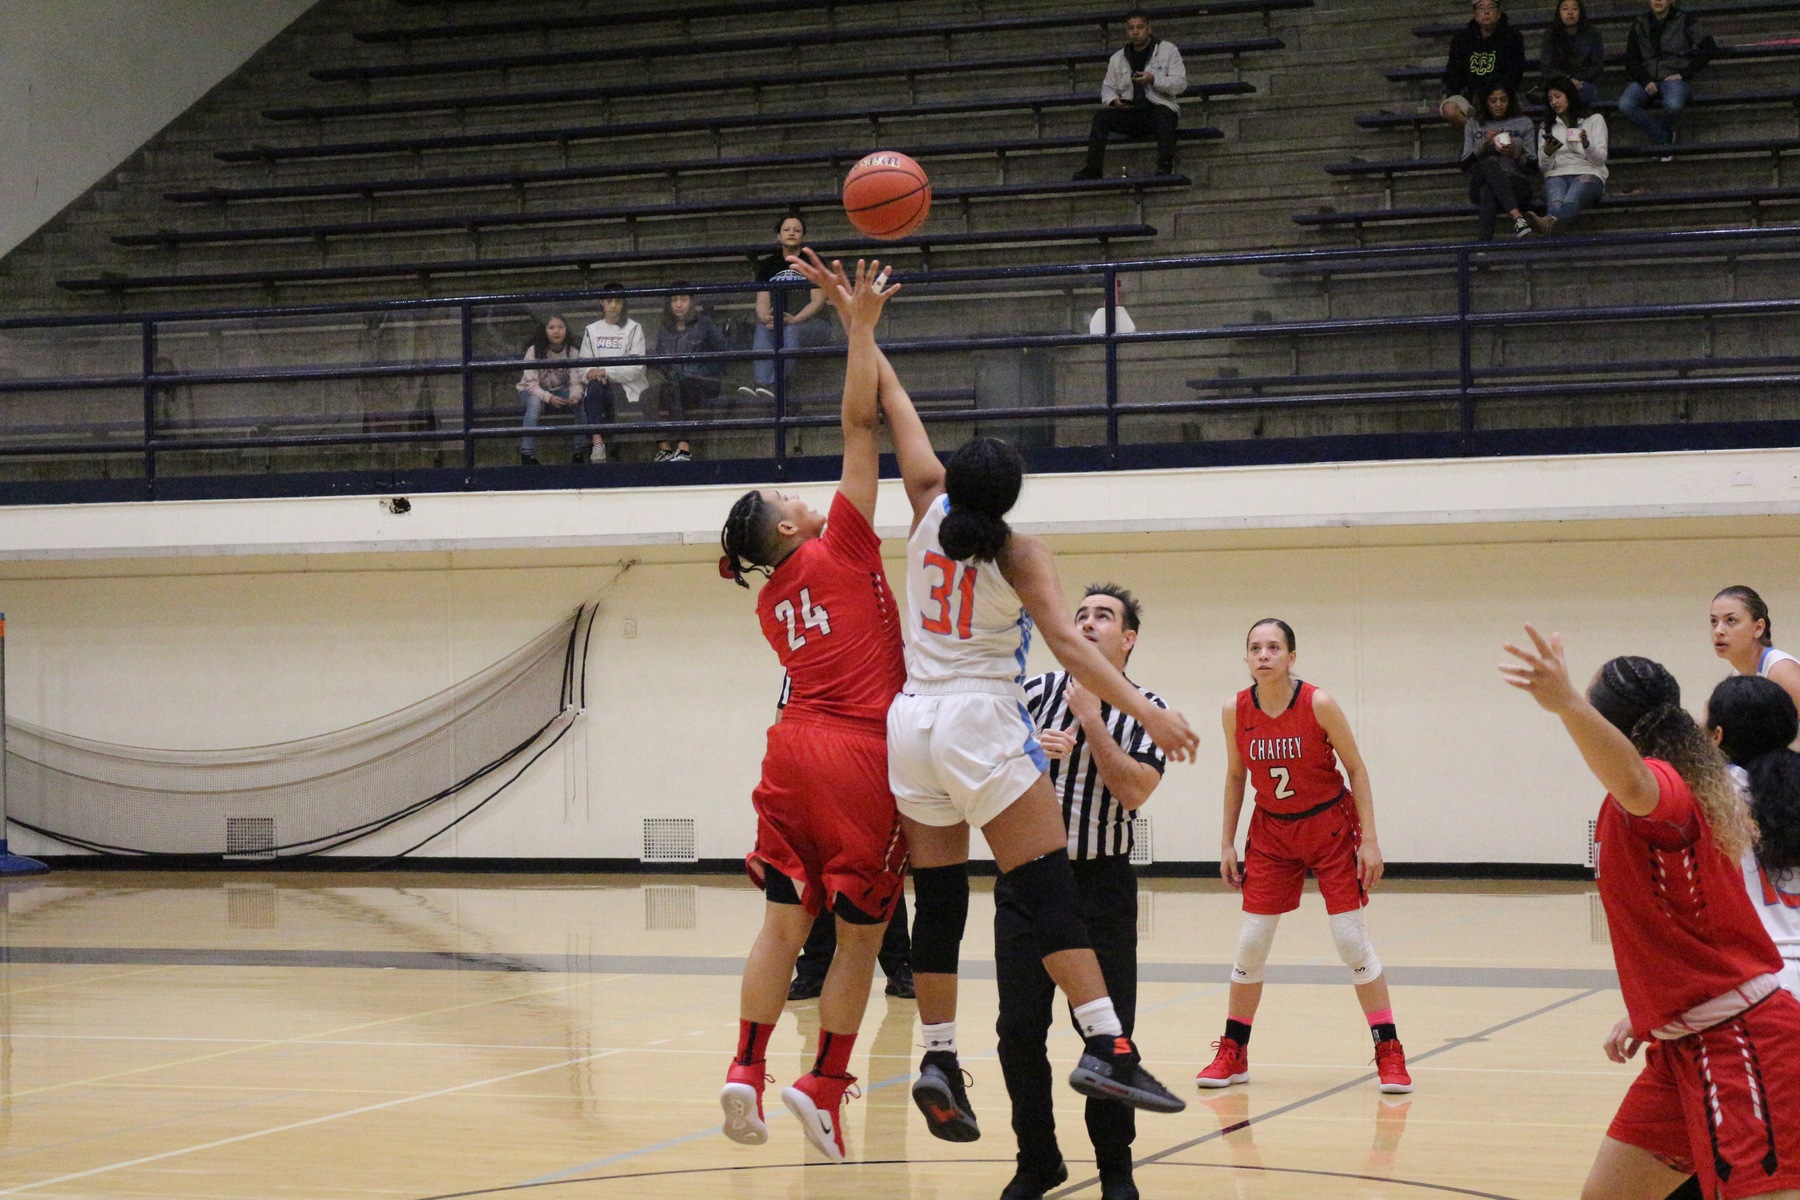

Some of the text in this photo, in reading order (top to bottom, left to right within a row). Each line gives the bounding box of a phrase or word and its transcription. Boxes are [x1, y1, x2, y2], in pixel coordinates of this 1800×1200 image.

[920, 549, 978, 640] 31
[774, 587, 833, 652] 24
[1249, 736, 1302, 761] CHAFFEY
[1268, 766, 1296, 800] 2
